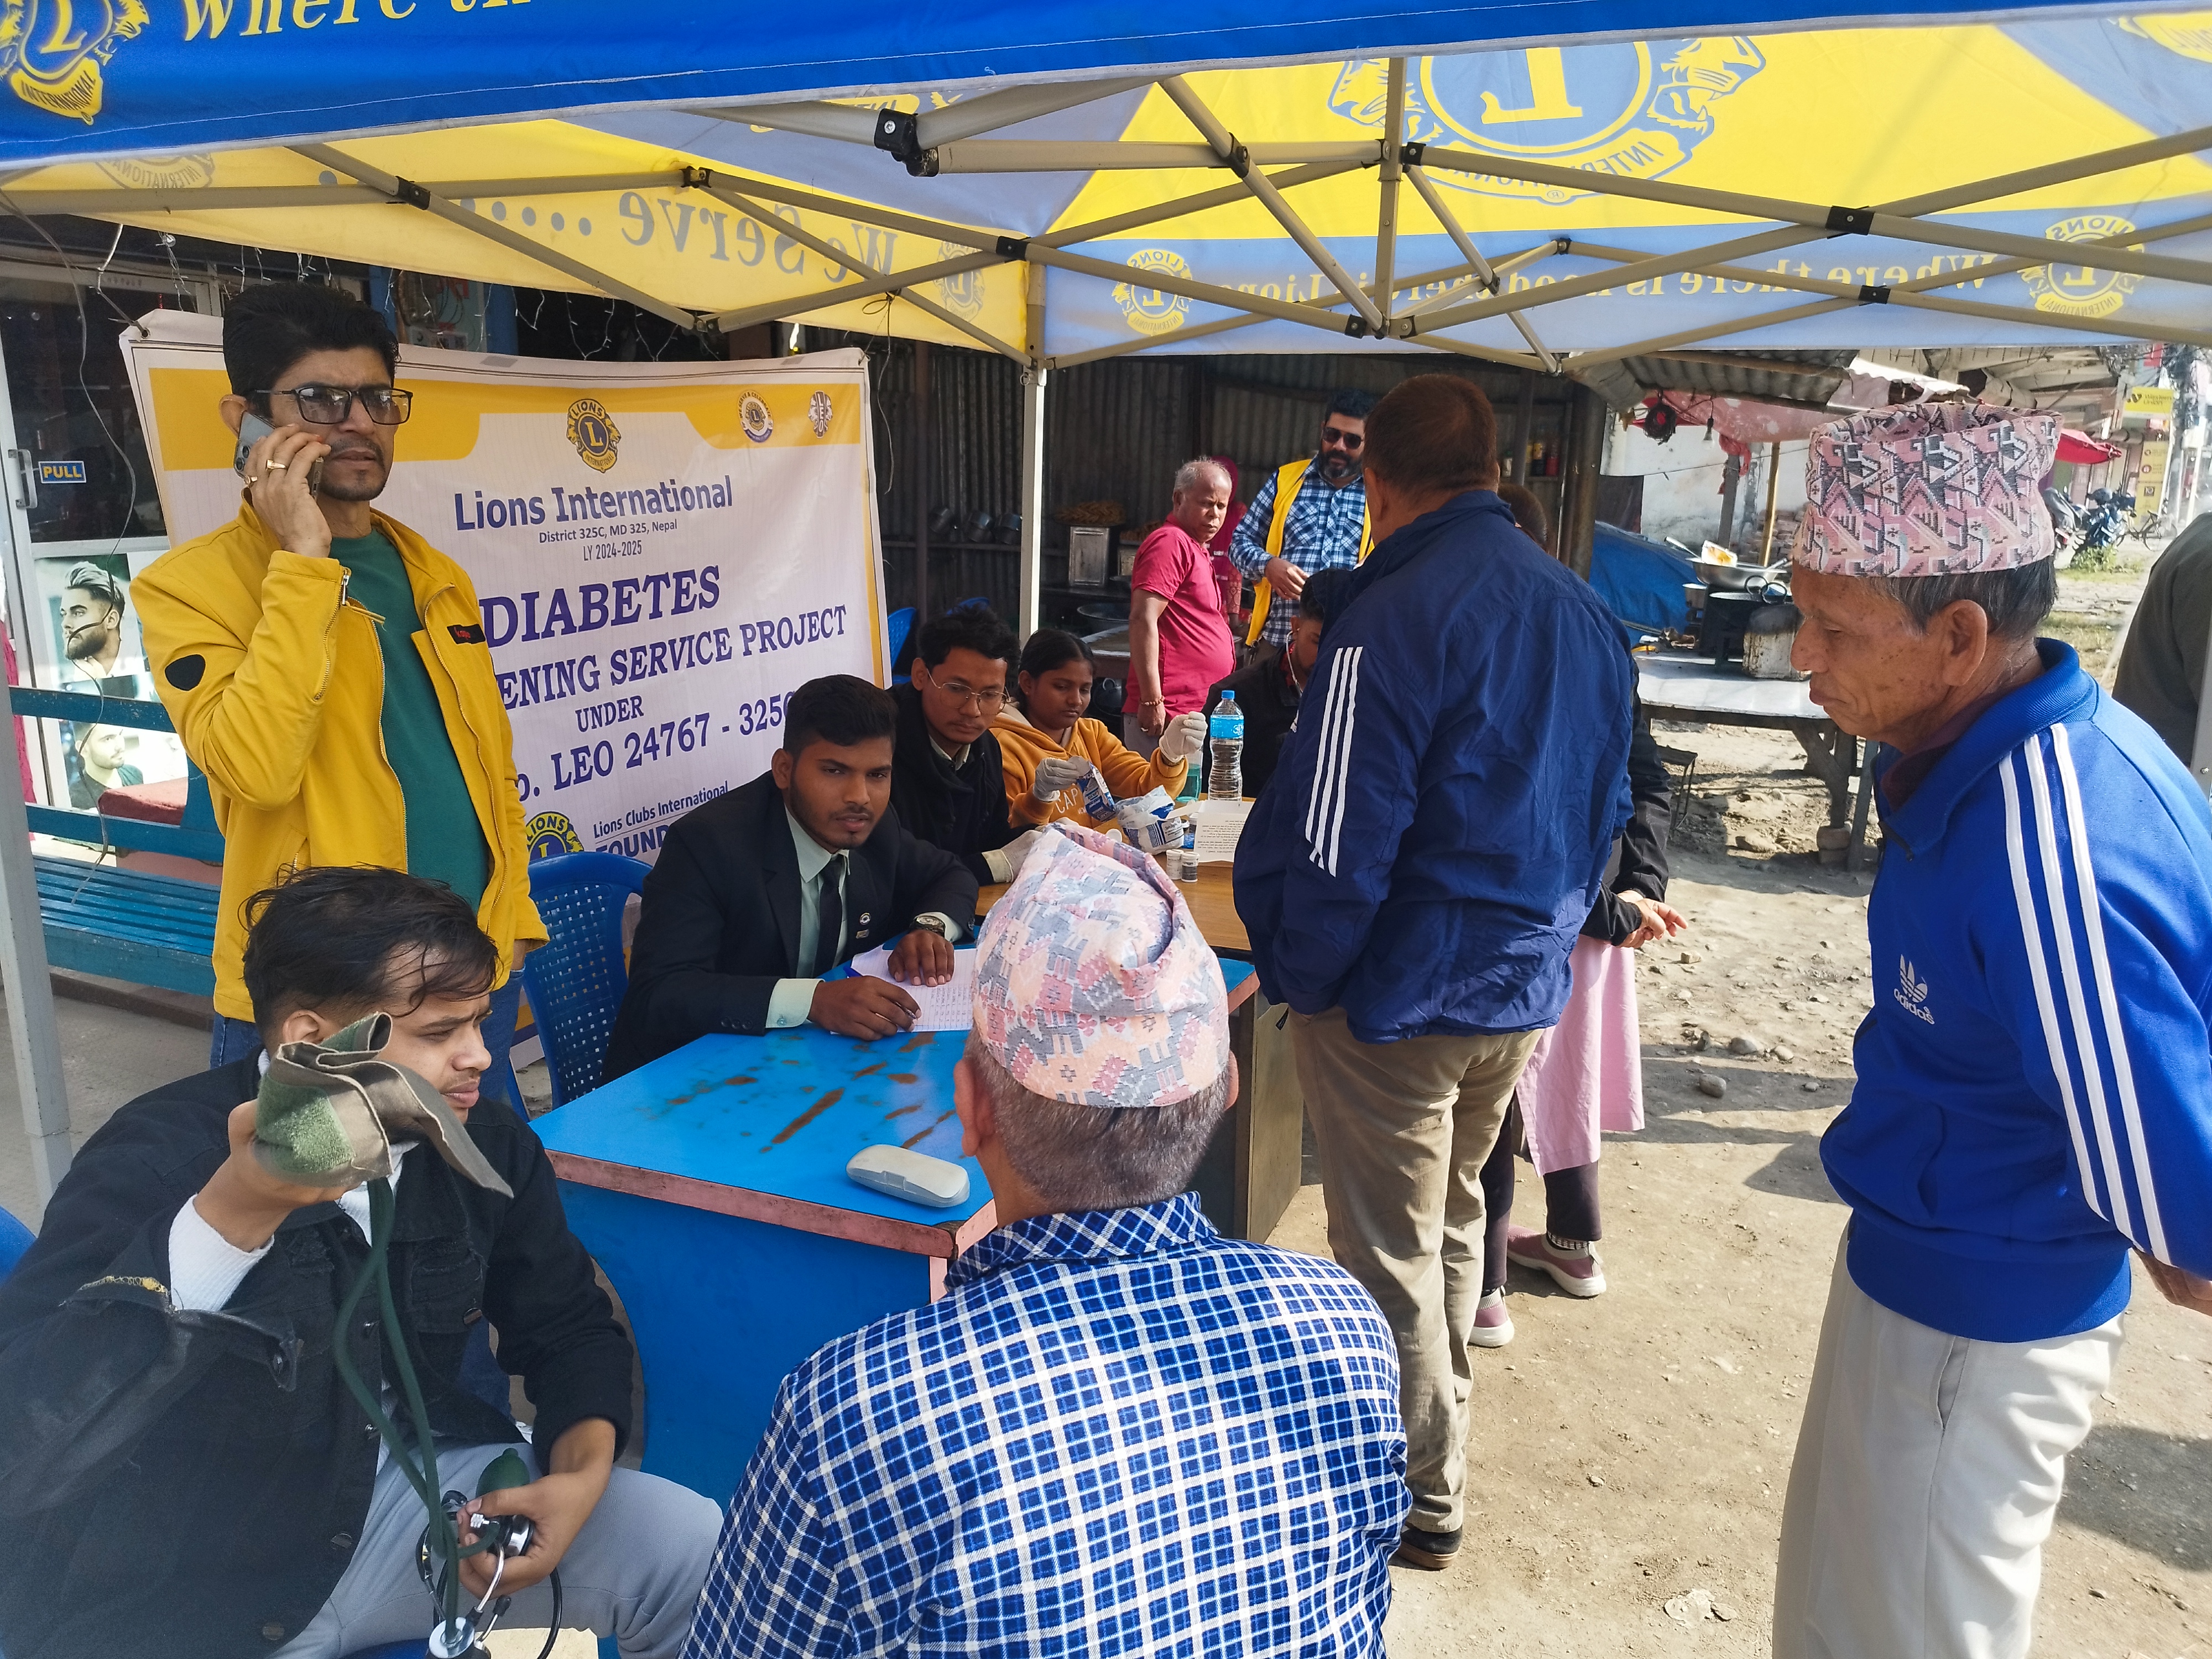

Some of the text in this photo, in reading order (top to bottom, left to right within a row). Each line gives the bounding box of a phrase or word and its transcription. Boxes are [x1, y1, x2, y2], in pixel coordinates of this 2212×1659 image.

[571, 401, 603, 416] LIONS
[43, 466, 82, 478] PULL
[455, 474, 733, 531] Lions International
[539, 519, 678, 544] District 325C, MD 325, Nepal
[583, 540, 642, 561] LY 2024-2025
[479, 564, 721, 648] DIABETES
[495, 605, 847, 710] ENING SERVICE PROJECT
[575, 696, 644, 733] UNDER
[518, 774, 540, 802] o.
[551, 741, 614, 791] LEO
[624, 712, 711, 770] 24767
[530, 815, 568, 837] IONS
[593, 780, 728, 839] Lions Clubs International
[1893, 988, 1935, 1025] adidas
